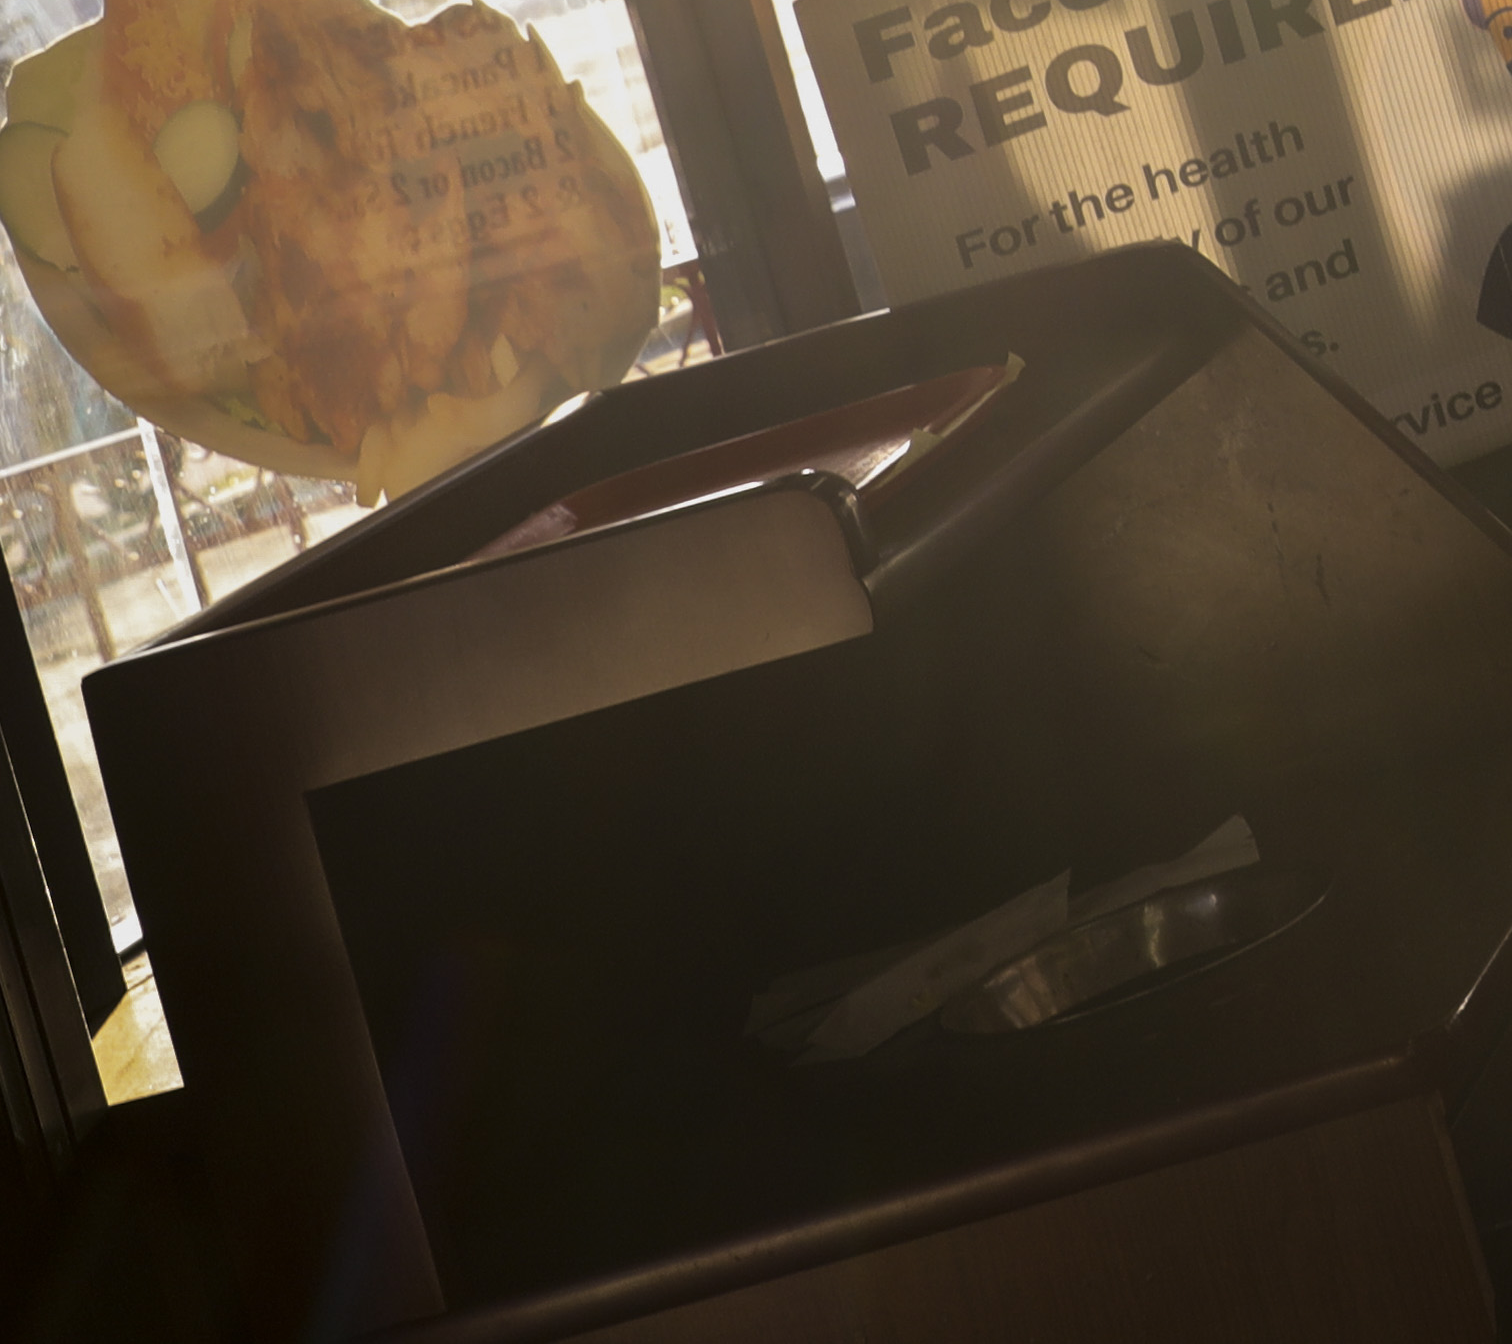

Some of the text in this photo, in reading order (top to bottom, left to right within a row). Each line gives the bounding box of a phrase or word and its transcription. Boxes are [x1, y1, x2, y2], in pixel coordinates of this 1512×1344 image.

[955, 121, 1306, 270] For the health
[1215, 197, 1266, 250] of
[1273, 174, 1356, 227] our
[1265, 239, 1362, 303] and
